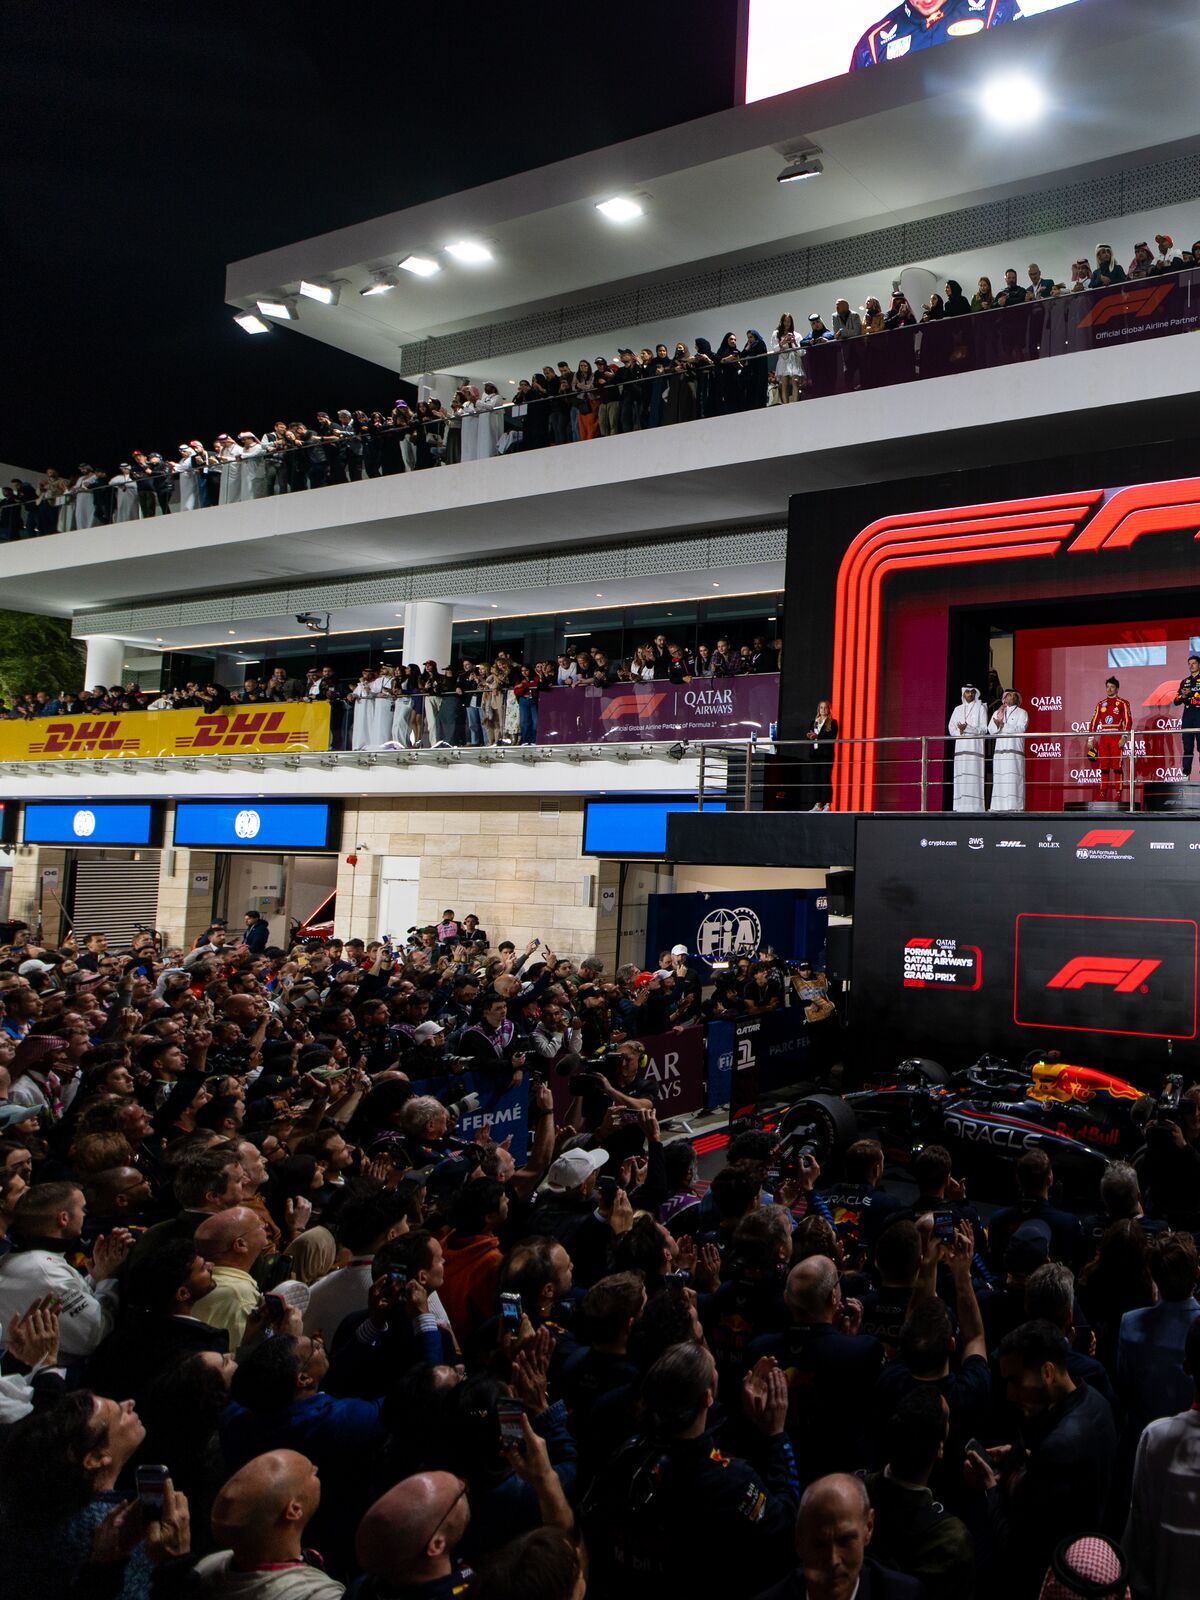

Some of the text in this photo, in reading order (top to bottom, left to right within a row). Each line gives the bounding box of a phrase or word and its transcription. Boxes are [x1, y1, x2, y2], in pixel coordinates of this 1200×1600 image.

[1095, 329, 1121, 340] Official
[1121, 326, 1144, 336] Global
[1145, 320, 1169, 331] Airline
[1170, 315, 1199, 327] Partner
[684, 689, 733, 708] QATAR
[1031, 696, 1062, 707] QATAR
[695, 704, 733, 715] AIRWAYS
[192, 712, 290, 747] DHL
[1157, 719, 1182, 729] QATA
[43, 720, 125, 752] DHL
[1030, 743, 1061, 753] QATAR
[1070, 769, 1101, 780] QATAR
[1156, 768, 1183, 778] QATA
[936, 938, 956, 947] QATAR
[904, 948, 953, 958] FORMULA 1
[904, 956, 973, 967] QATAR AIRWAYS
[904, 964, 933, 972] QATAR
[904, 971, 956, 982] GRAND PRIX
[1045, 956, 1163, 993] F1
[736, 1023, 760, 1035] QATAR
[462, 1103, 522, 1131] FERMÉ
[944, 1118, 1043, 1150] ORACLE
[1088, 1126, 1121, 1146] Bull
